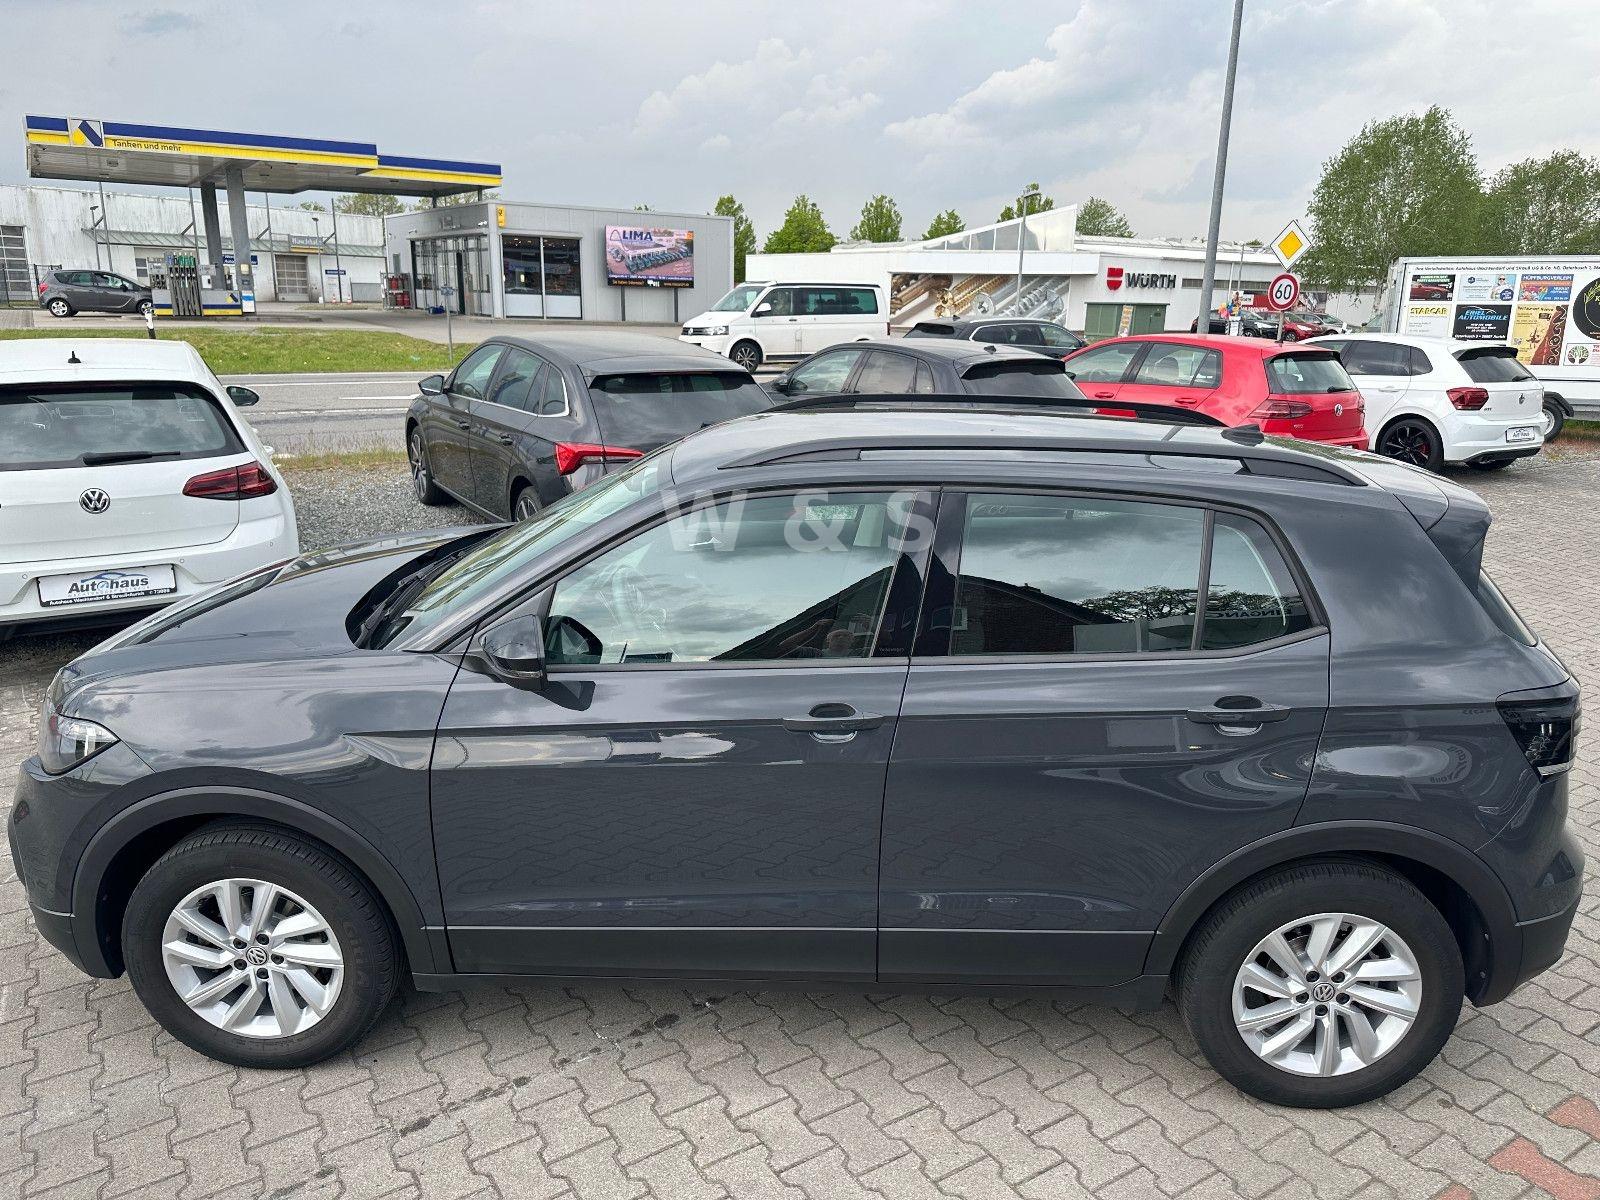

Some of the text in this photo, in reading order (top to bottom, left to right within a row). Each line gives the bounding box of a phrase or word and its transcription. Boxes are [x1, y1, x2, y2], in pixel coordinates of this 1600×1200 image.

[112, 139, 182, 152] Tanken und mehr
[622, 230, 653, 241] LIMA
[1125, 272, 1177, 289] WÜRTH
[1275, 283, 1292, 300] 60
[1410, 307, 1448, 315] STARCAR
[67, 577, 149, 594] Autohaus
